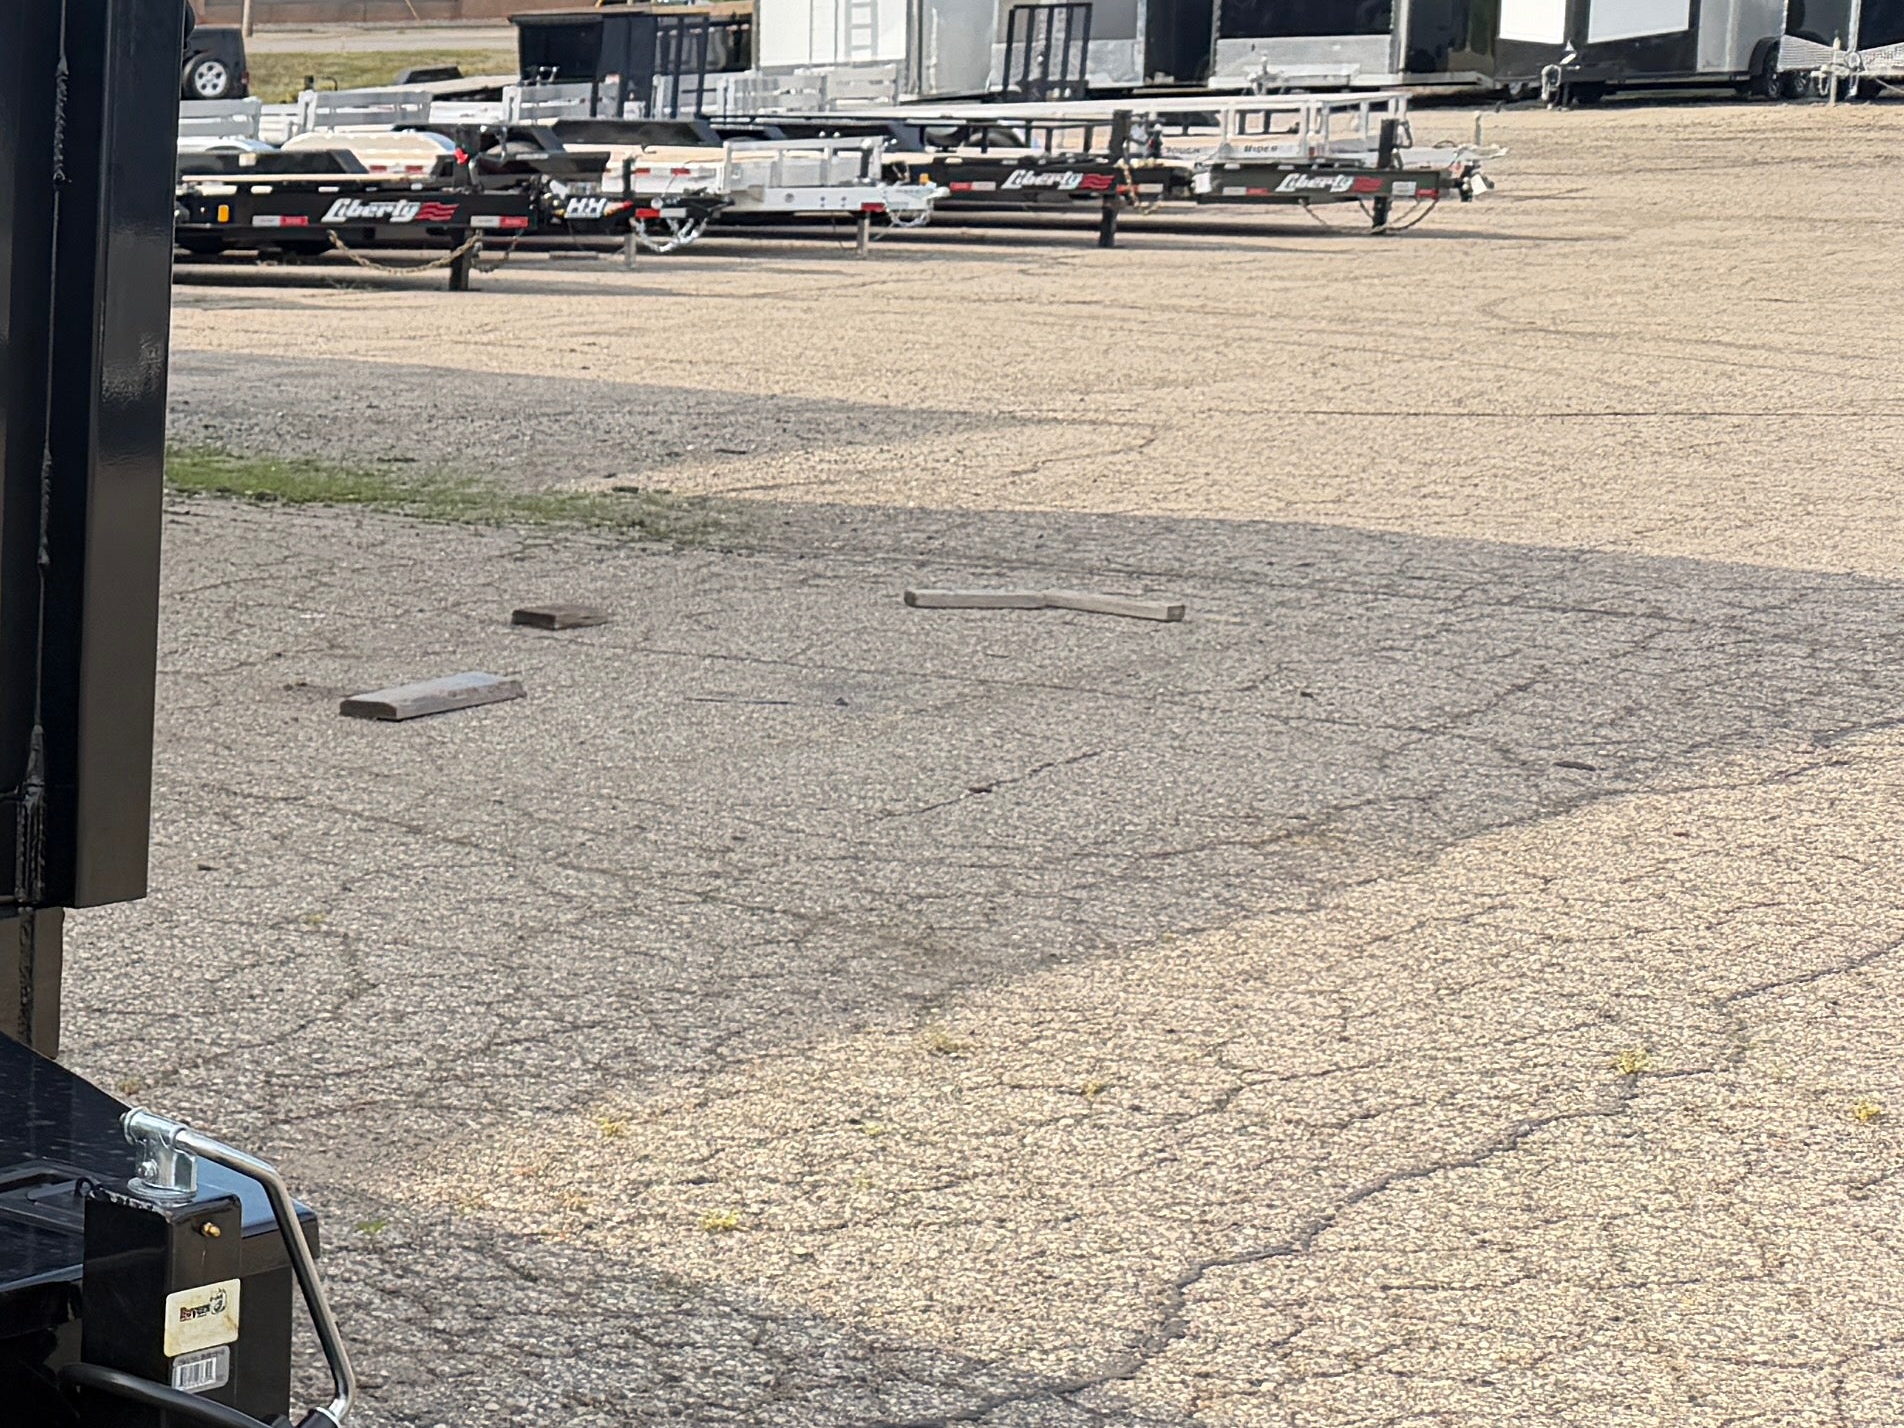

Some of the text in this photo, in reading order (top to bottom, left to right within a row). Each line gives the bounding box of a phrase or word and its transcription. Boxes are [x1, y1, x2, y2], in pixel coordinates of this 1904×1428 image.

[1001, 170, 1084, 191] Liberty
[1275, 172, 1357, 192] Liberty
[321, 198, 422, 223] Liberty
